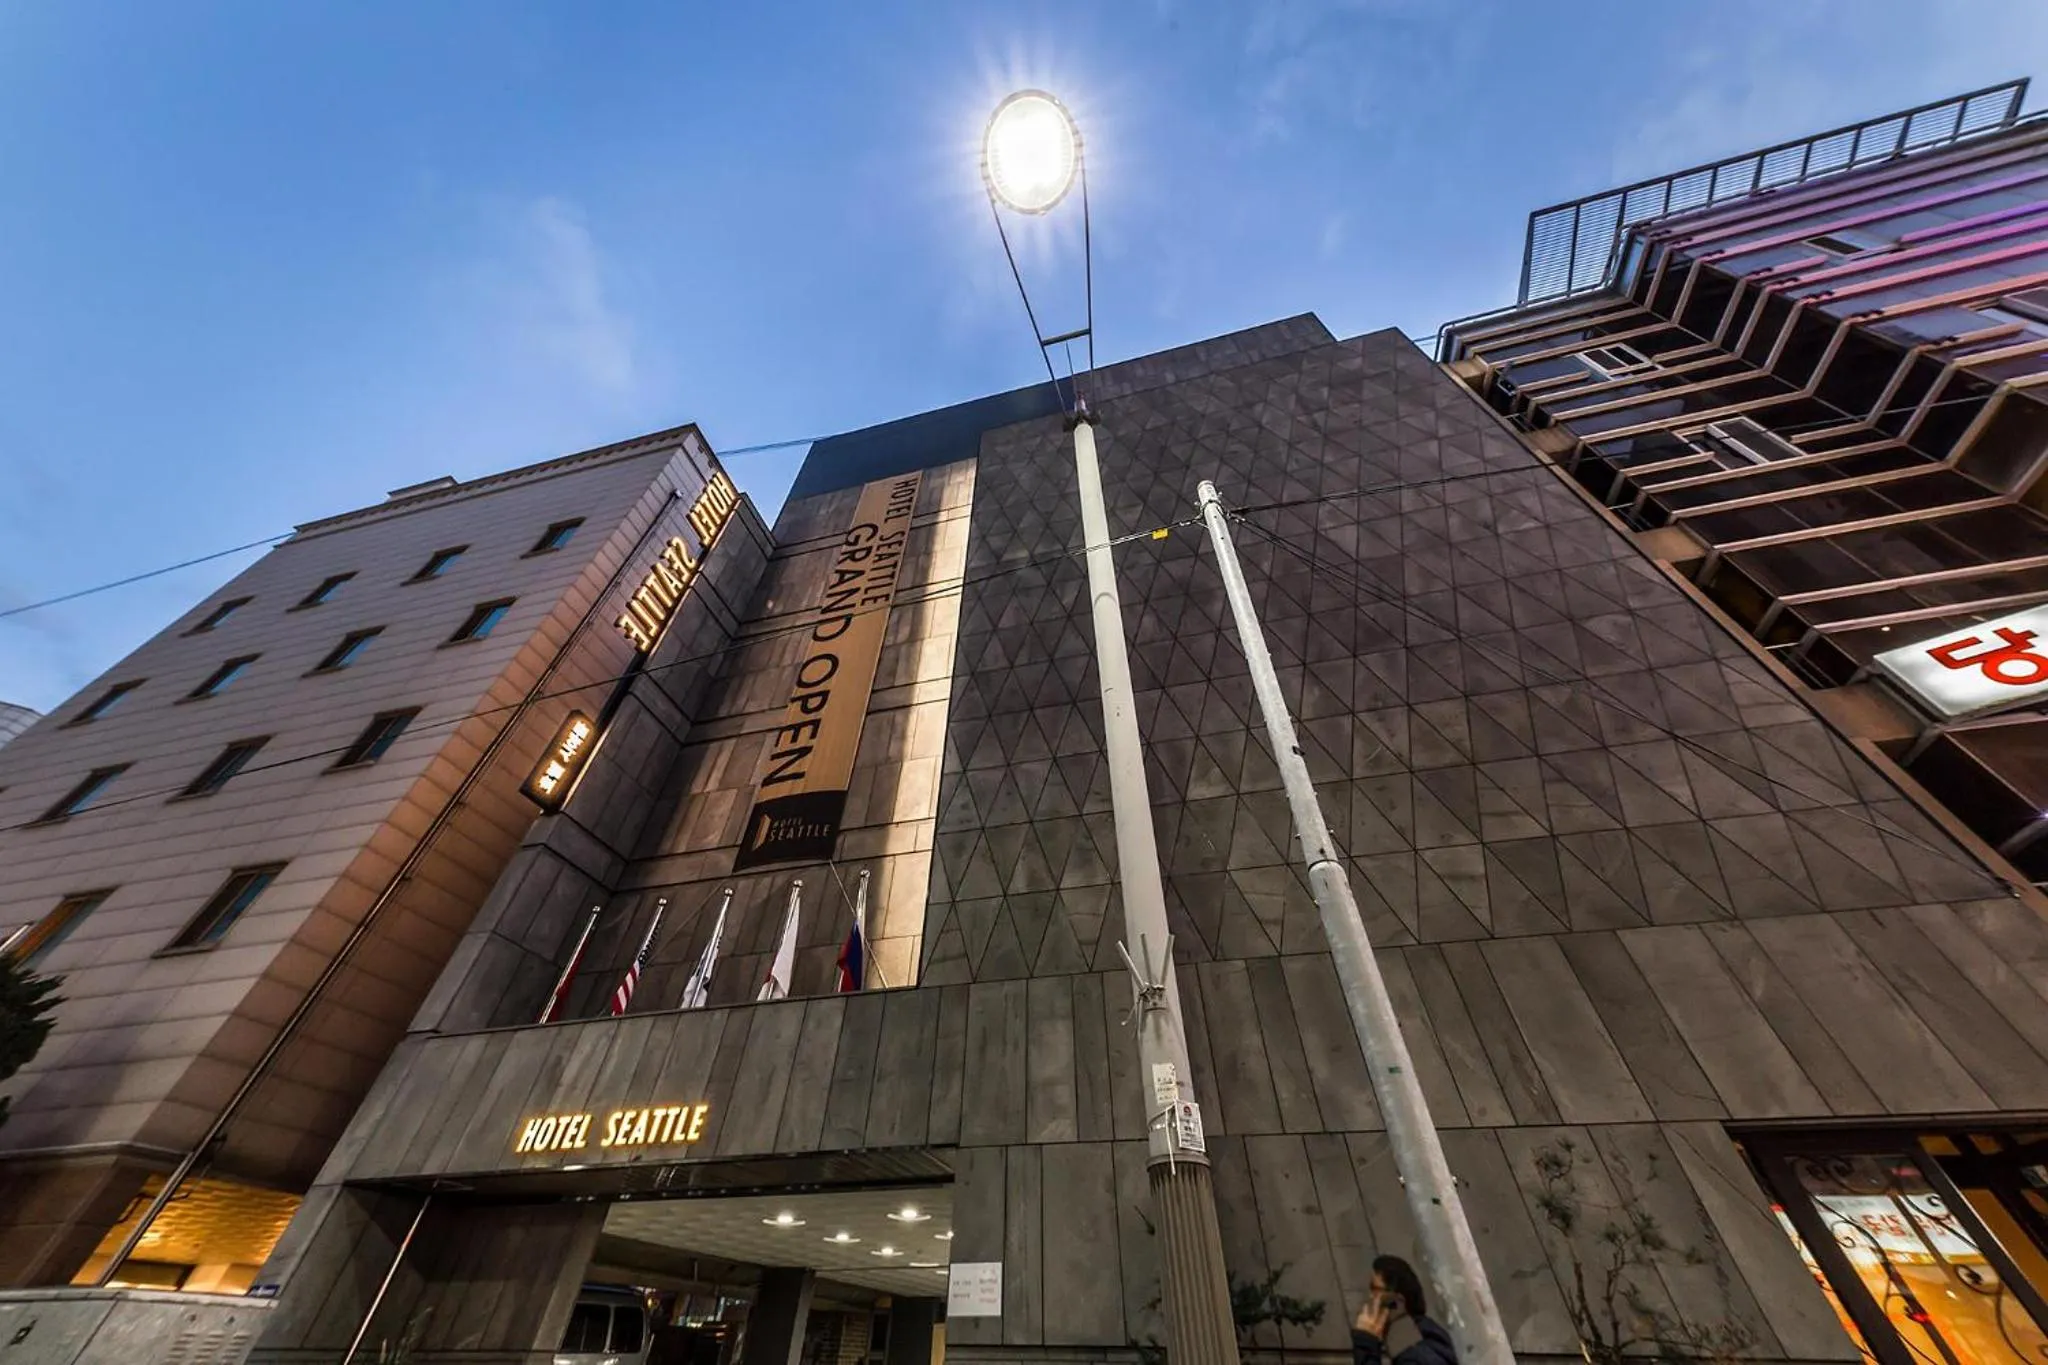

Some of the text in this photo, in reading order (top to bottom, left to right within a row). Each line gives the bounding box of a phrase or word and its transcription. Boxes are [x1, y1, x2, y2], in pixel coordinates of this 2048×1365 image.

[860, 477, 918, 607] HOTEL SEATTLE
[761, 523, 879, 788] GRAND OPEN
[769, 823, 832, 842] SEATTLE
[515, 1105, 709, 1152] HOTEL SEATTLE
